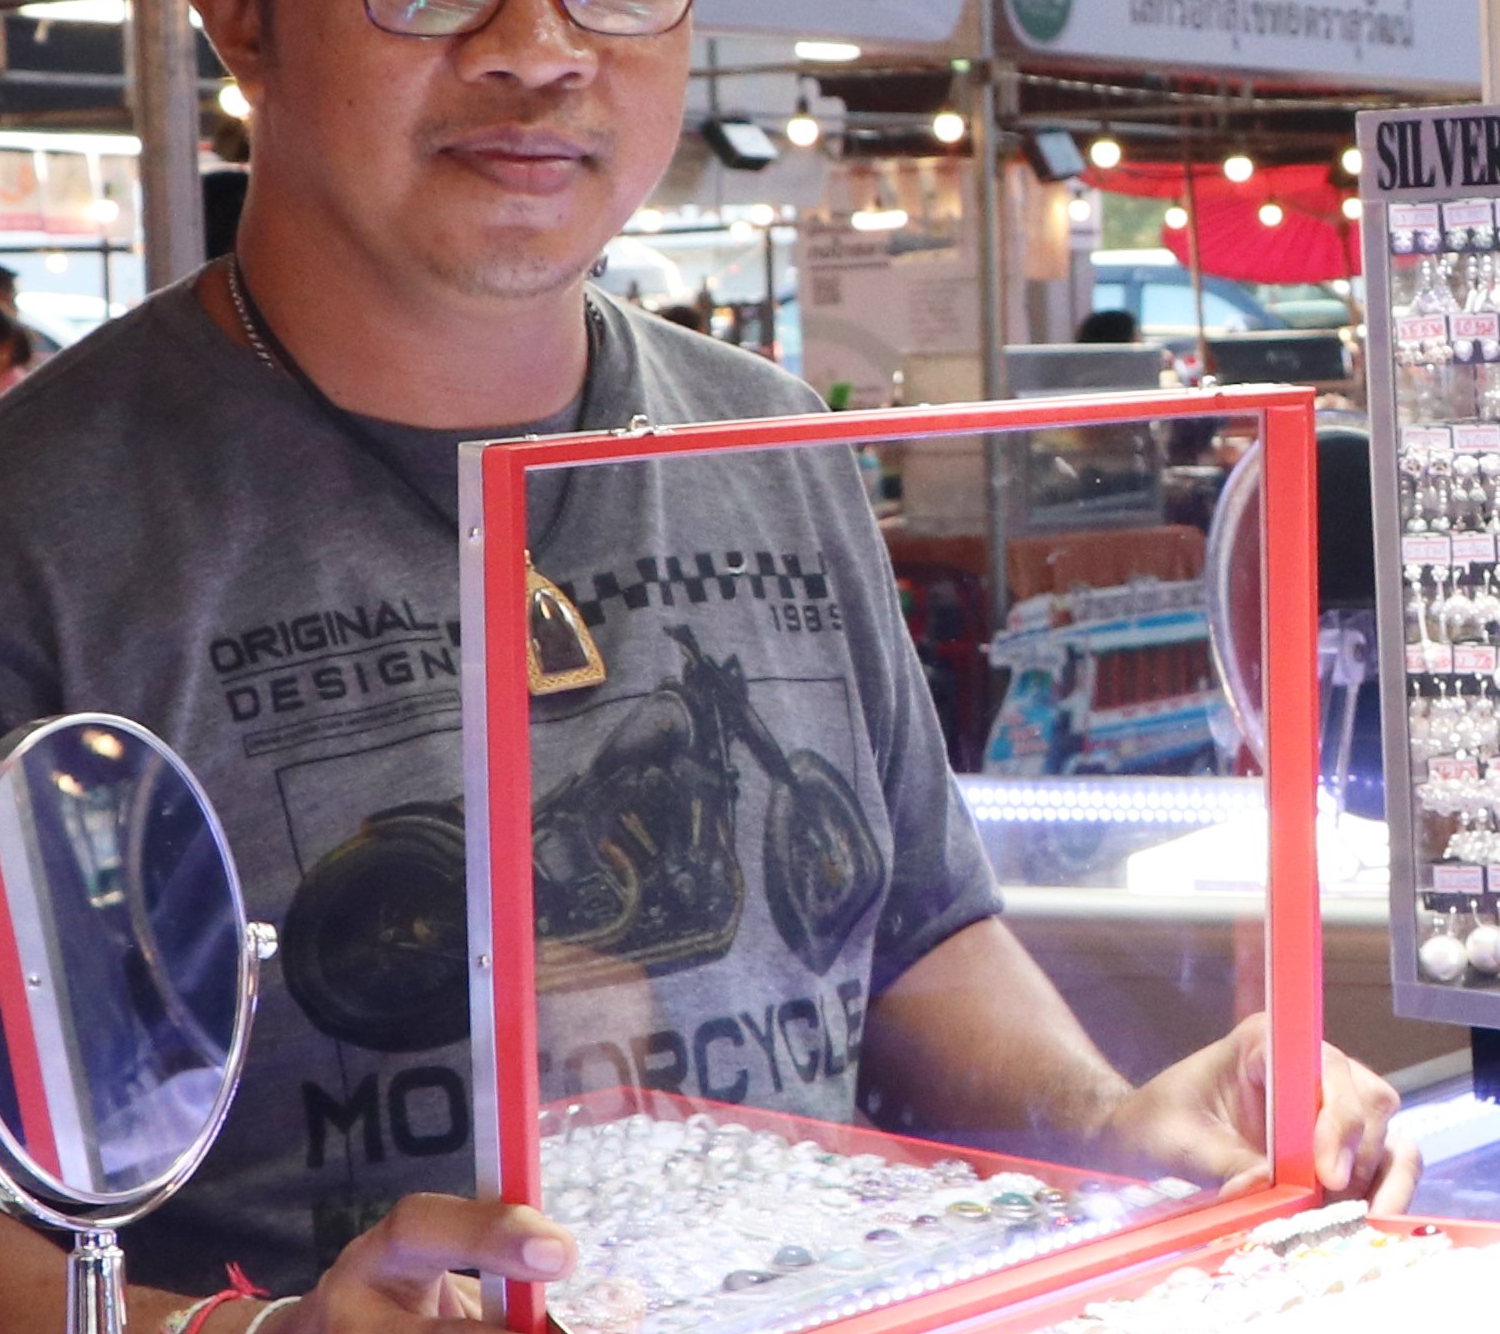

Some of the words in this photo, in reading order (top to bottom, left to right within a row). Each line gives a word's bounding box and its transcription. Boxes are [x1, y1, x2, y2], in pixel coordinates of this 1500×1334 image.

[209, 598, 440, 674] ORIGINAL
[226, 646, 457, 723] DESIGN
[302, 979, 864, 1169] MOORCYCLE
